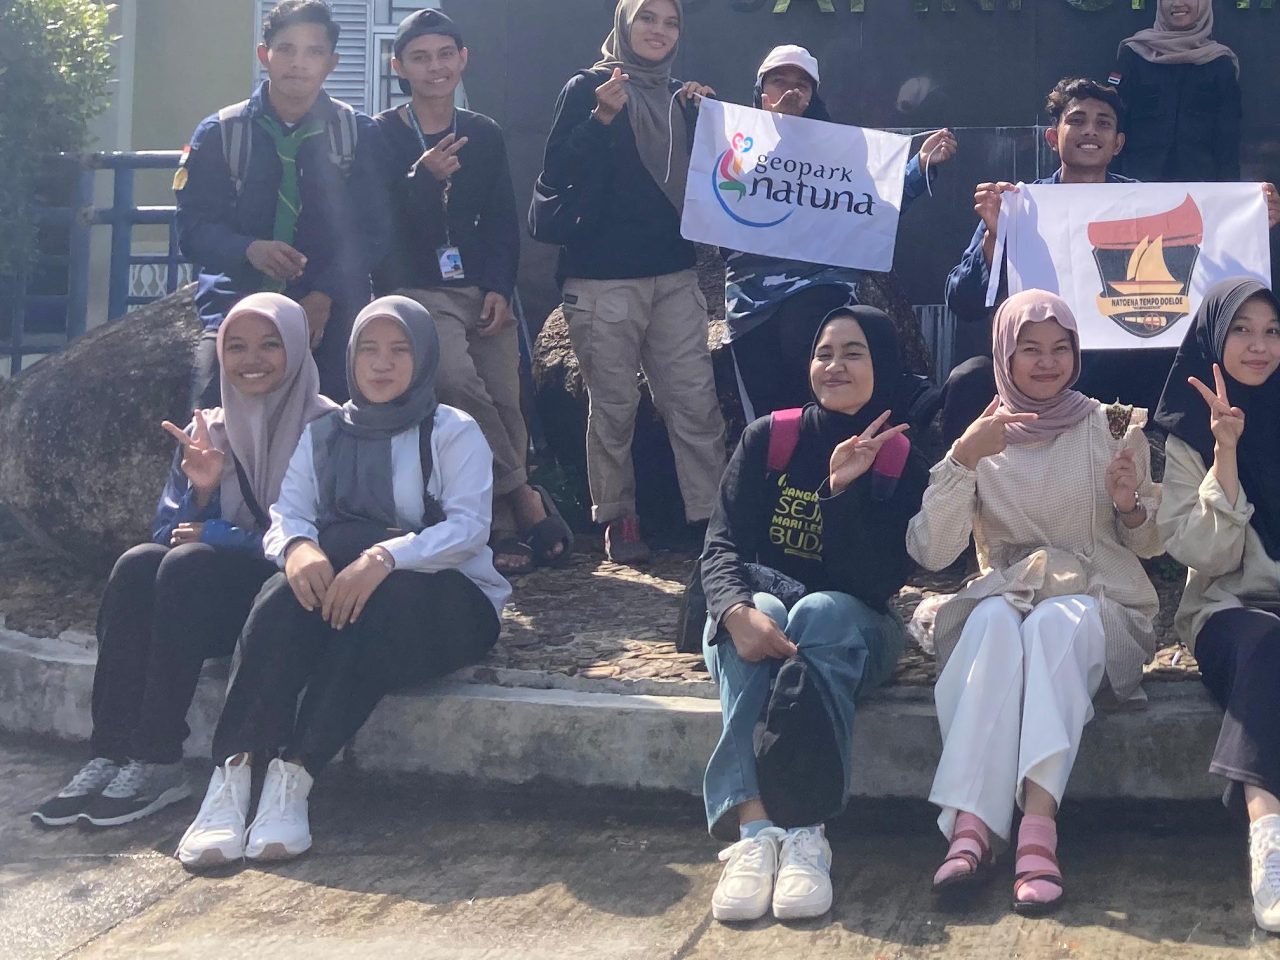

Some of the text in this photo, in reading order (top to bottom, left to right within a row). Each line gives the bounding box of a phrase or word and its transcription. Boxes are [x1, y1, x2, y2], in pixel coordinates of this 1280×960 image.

[754, 154, 853, 182] geopark
[749, 176, 876, 216] natuna
[1112, 296, 1183, 306] NATOENA TEMPO DOELOE
[772, 514, 802, 529] MARI
